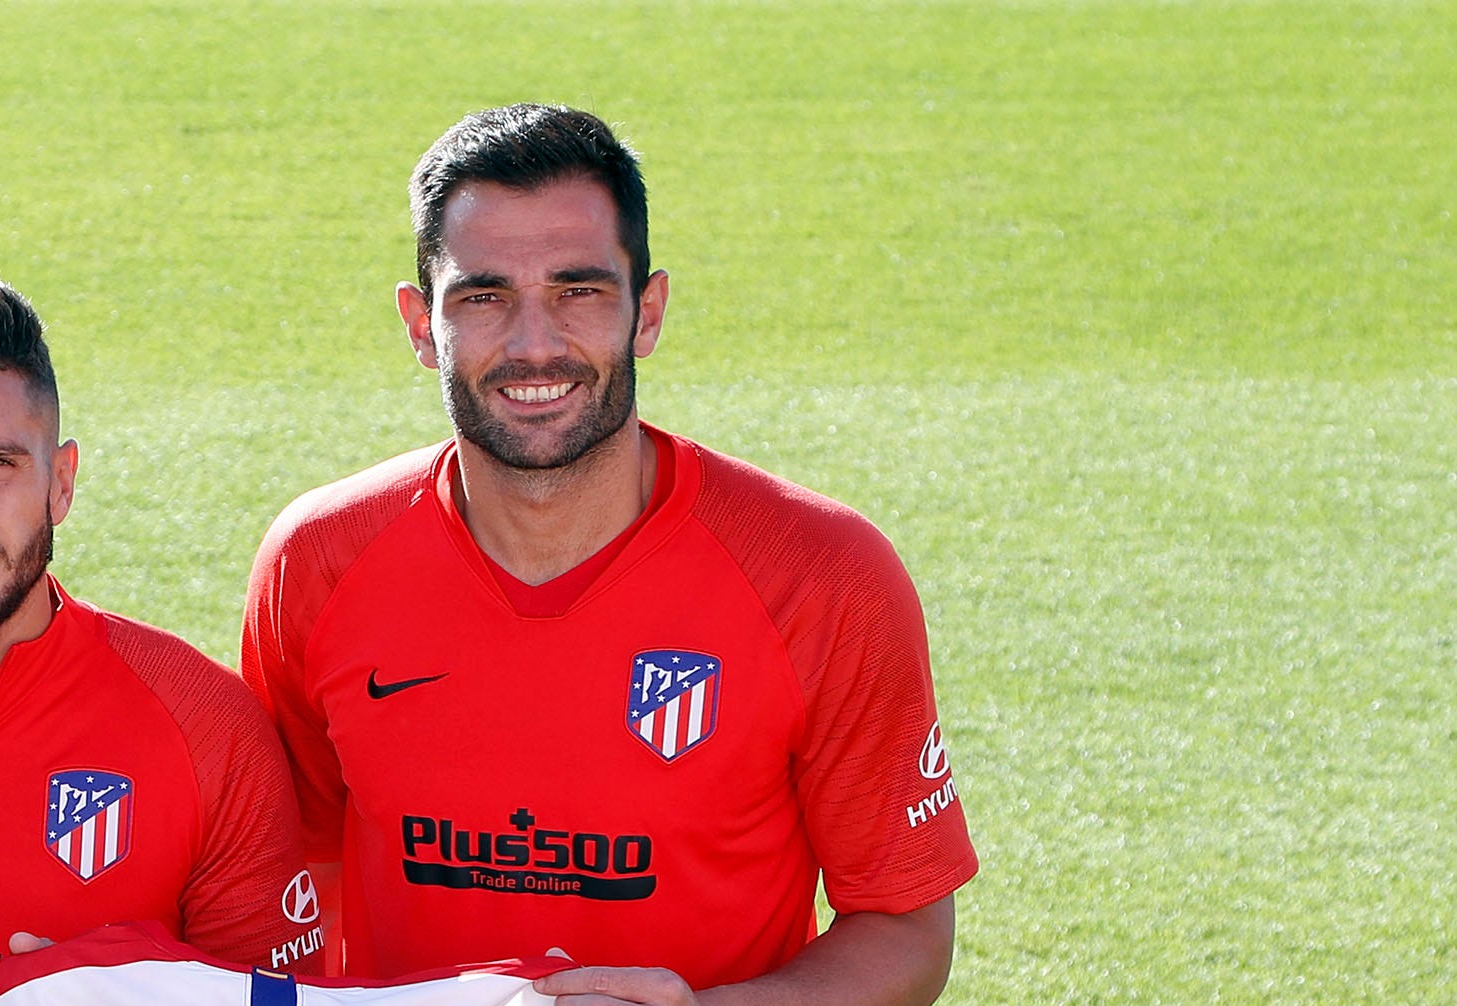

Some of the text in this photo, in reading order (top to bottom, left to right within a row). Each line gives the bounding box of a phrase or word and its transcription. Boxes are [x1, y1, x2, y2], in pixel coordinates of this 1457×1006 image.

[402, 815, 652, 875] Plus500
[470, 871, 582, 892] Trade Online
